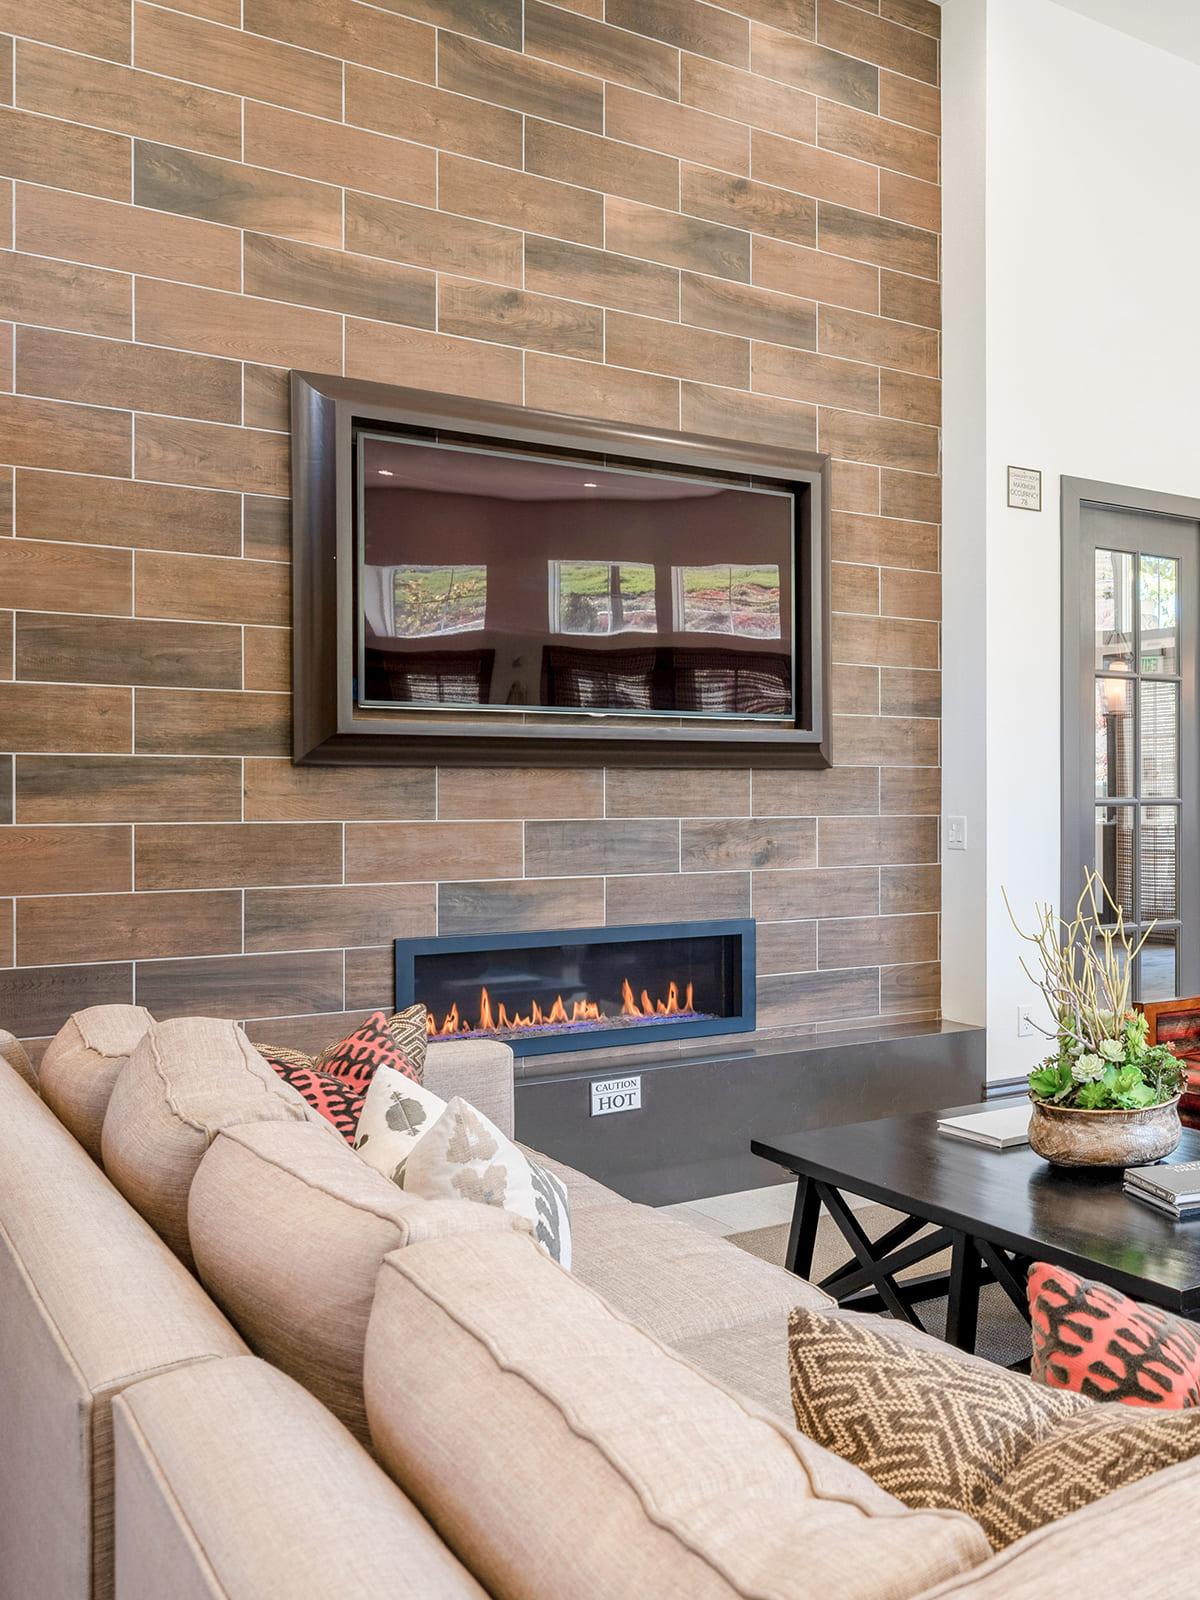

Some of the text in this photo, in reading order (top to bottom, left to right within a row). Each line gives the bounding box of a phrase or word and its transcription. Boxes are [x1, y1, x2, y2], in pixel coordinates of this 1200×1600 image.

[1013, 481, 1036, 490] MAXIMUM
[1011, 488, 1039, 499] OCCUPANCY
[596, 1079, 637, 1092] CAUTION
[598, 1092, 636, 1111] HOT
